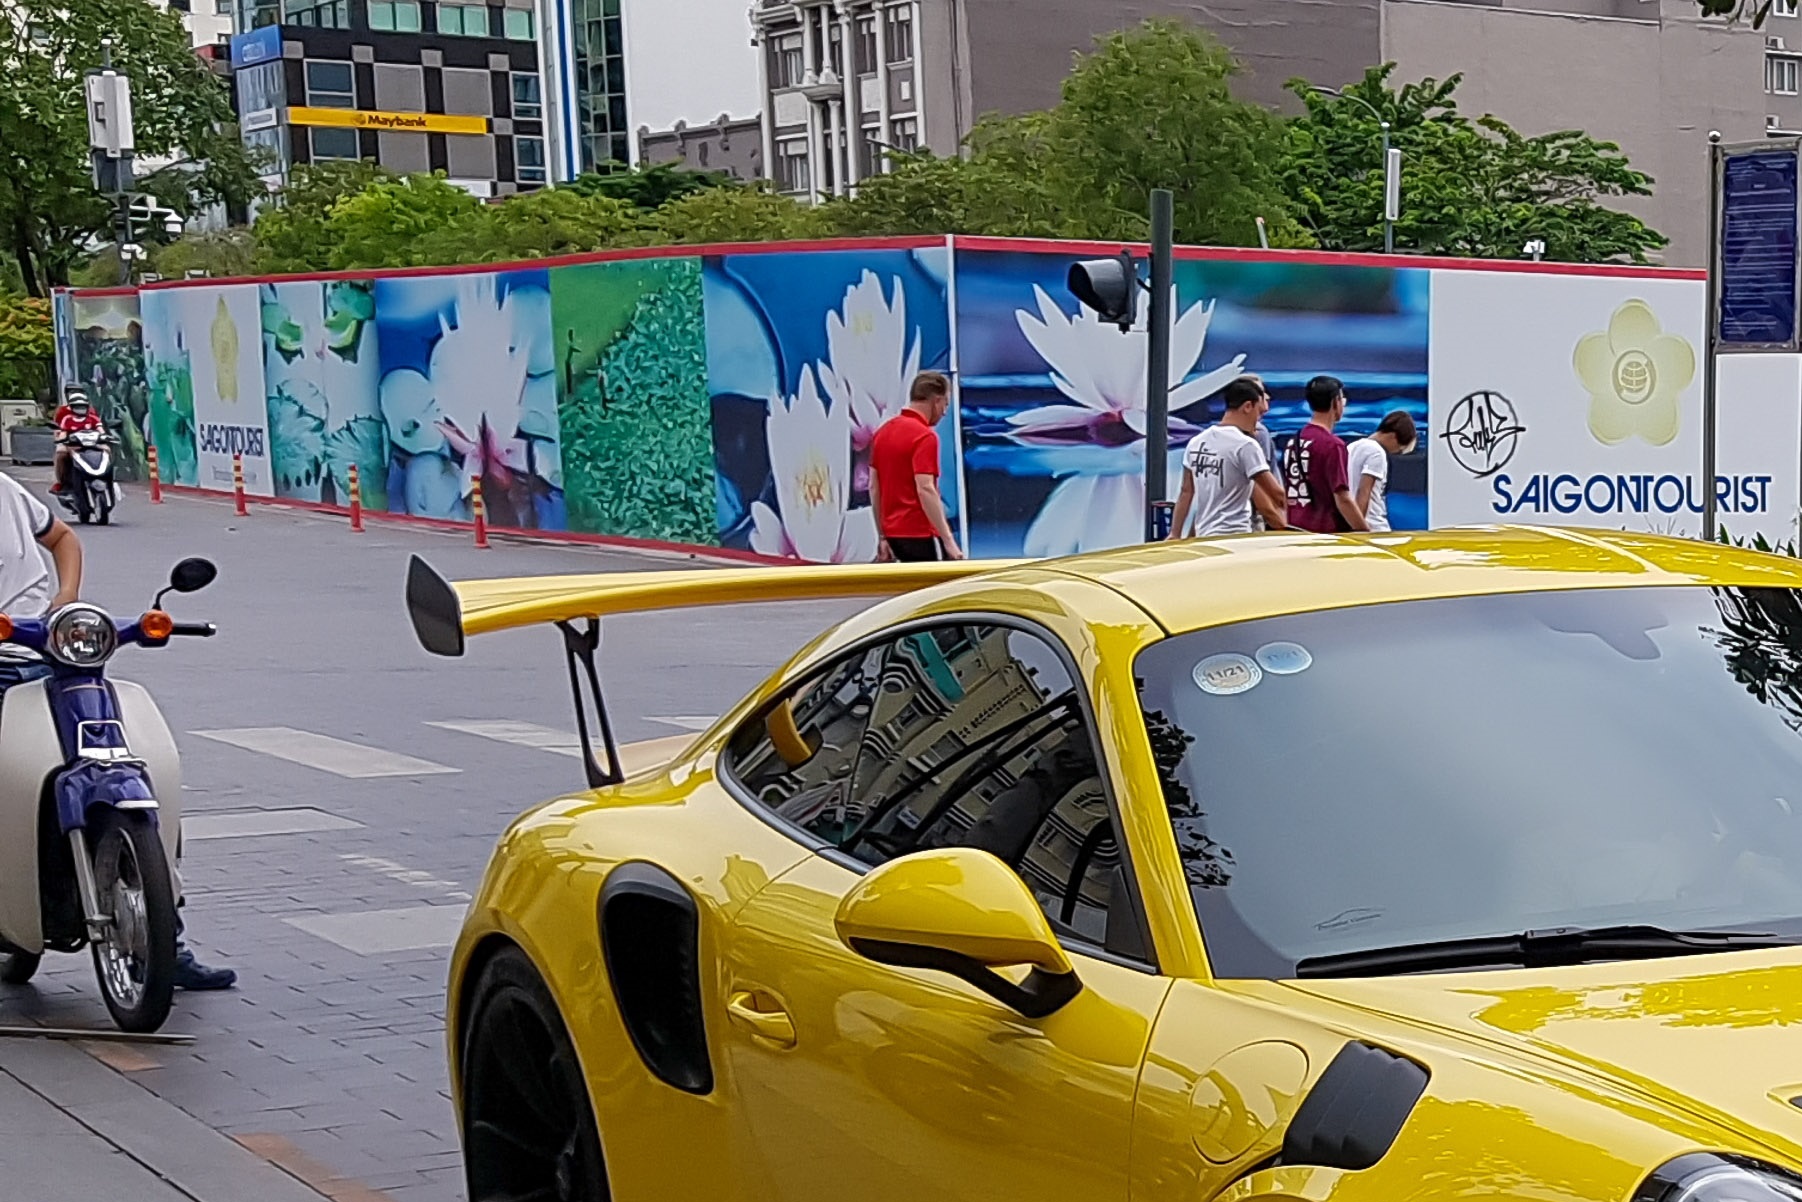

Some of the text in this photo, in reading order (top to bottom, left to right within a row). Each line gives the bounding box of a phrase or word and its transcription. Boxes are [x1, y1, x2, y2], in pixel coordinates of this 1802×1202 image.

[367, 114, 427, 128] Maybank
[1492, 473, 1772, 514] SAIGONTOURIST
[1207, 665, 1245, 681] 11/21
